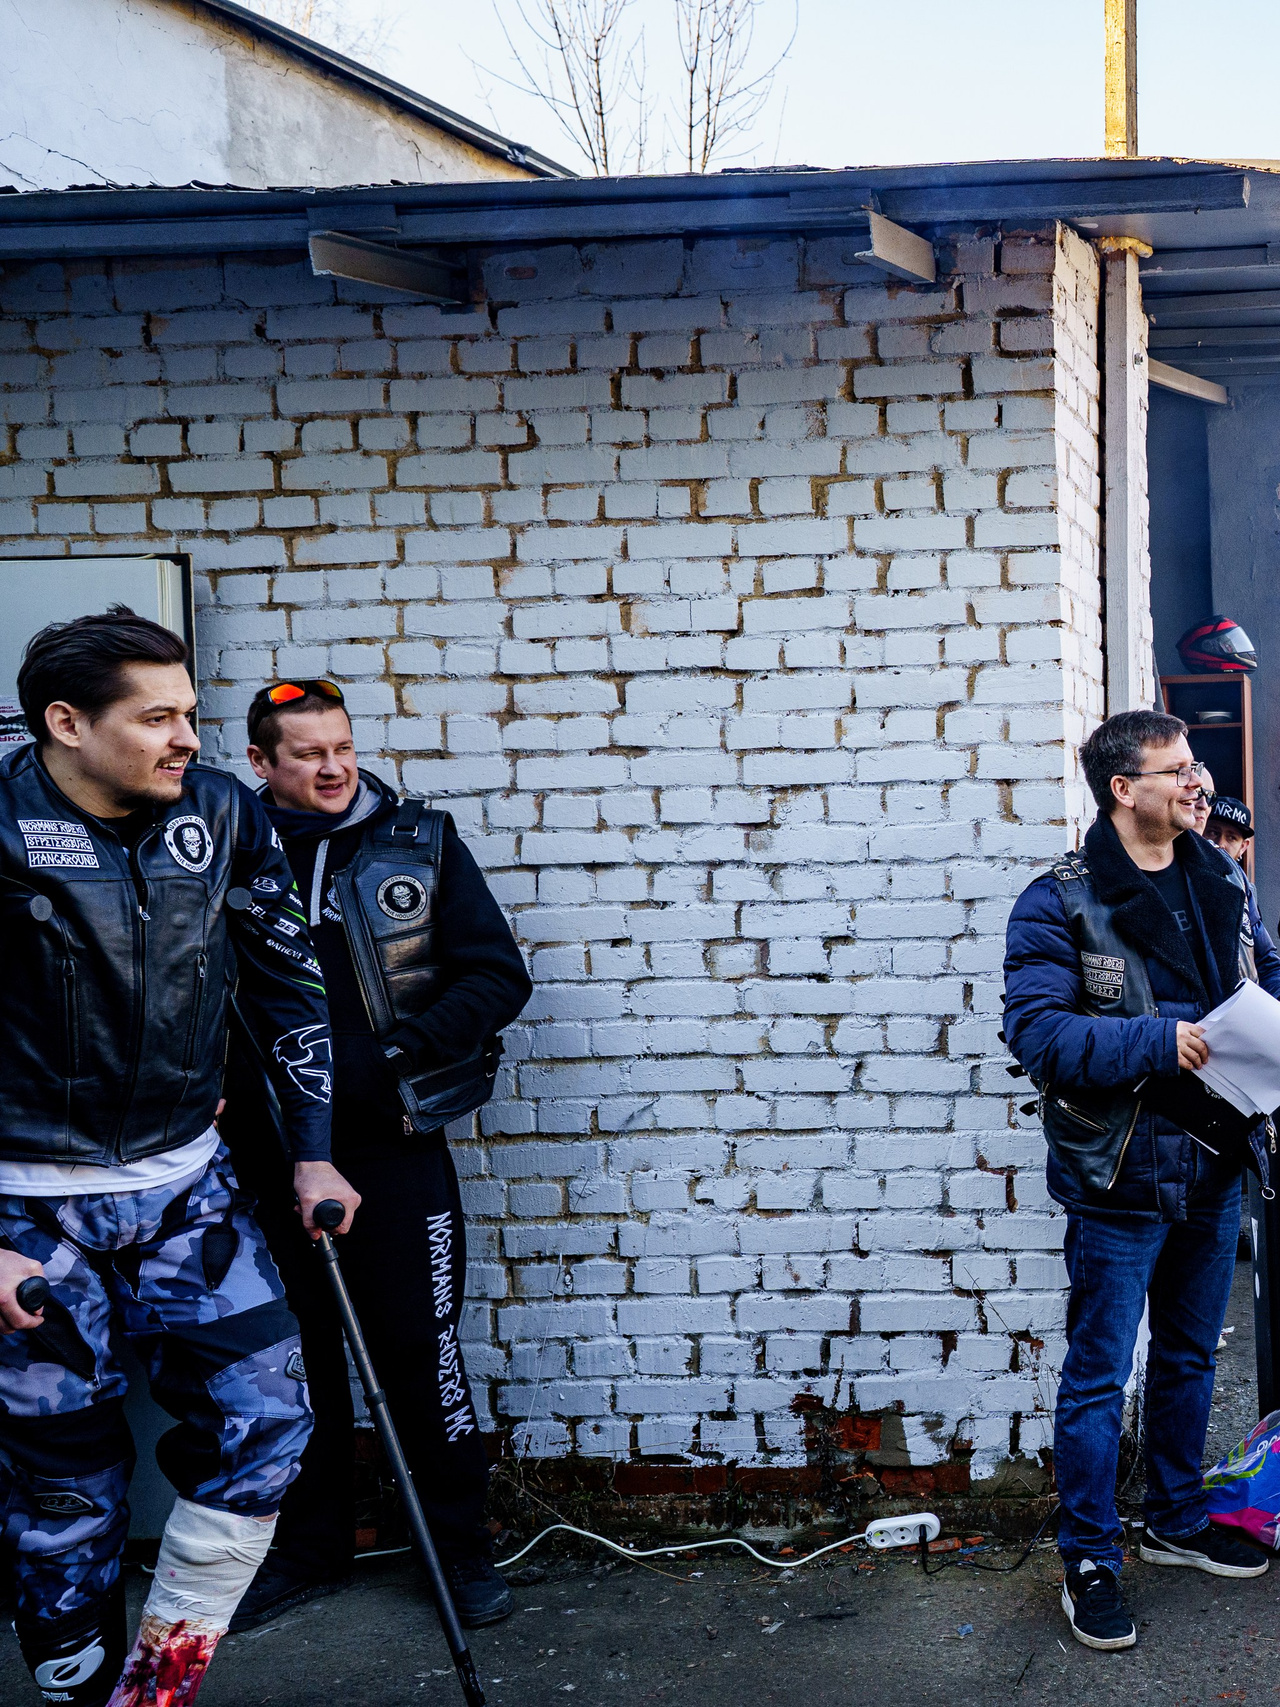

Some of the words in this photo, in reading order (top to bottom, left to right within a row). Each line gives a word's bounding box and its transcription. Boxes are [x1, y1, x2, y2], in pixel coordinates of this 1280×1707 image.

[1213, 803, 1247, 825] NRMC
[31, 853, 97, 866] HANGAROUND
[276, 920, 299, 935] GET
[426, 1211, 453, 1319] NORMANS
[438, 1324, 466, 1407] RIDERS
[444, 1405, 475, 1442] MC
